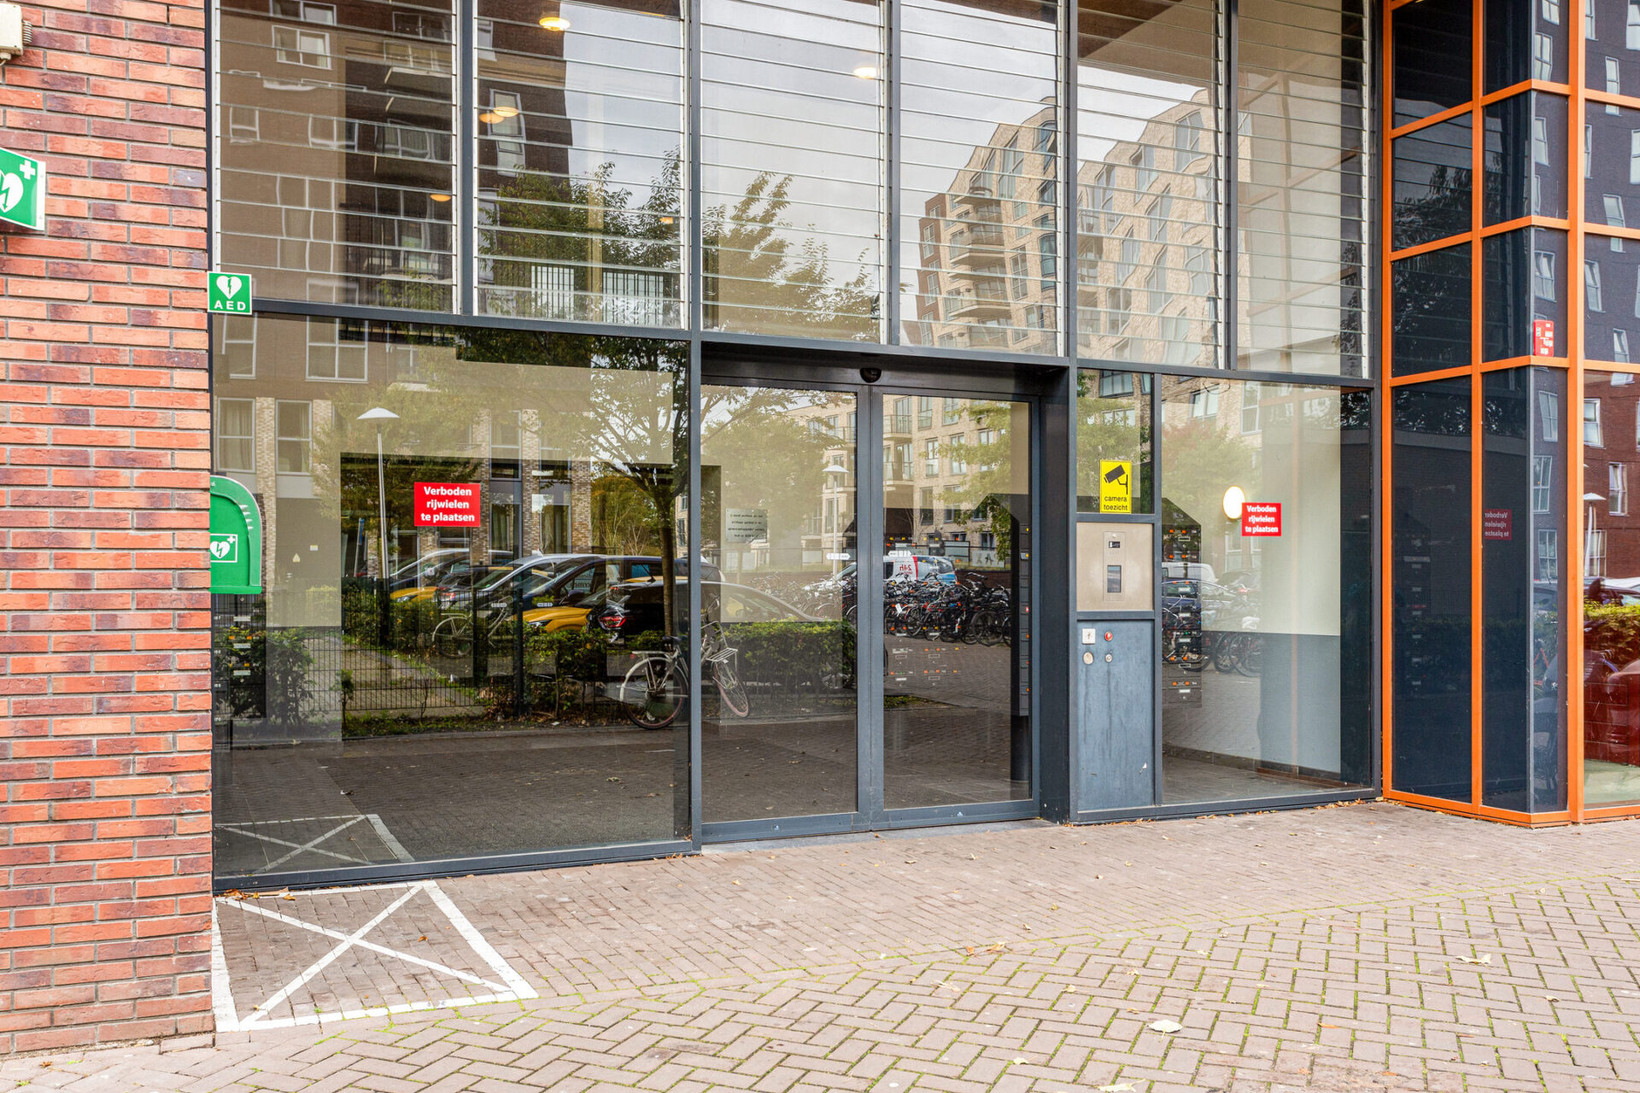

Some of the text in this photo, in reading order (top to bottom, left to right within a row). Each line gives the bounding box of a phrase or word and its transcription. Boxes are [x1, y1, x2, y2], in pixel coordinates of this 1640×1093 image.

[213, 300, 246, 311] AED
[423, 486, 472, 496] Verboden
[426, 499, 470, 510] rijwielen
[1246, 505, 1277, 513] Verboden
[420, 512, 475, 523] te plaatsen
[1248, 515, 1275, 524] rijwielen
[1252, 525, 1279, 534] plaatsen
